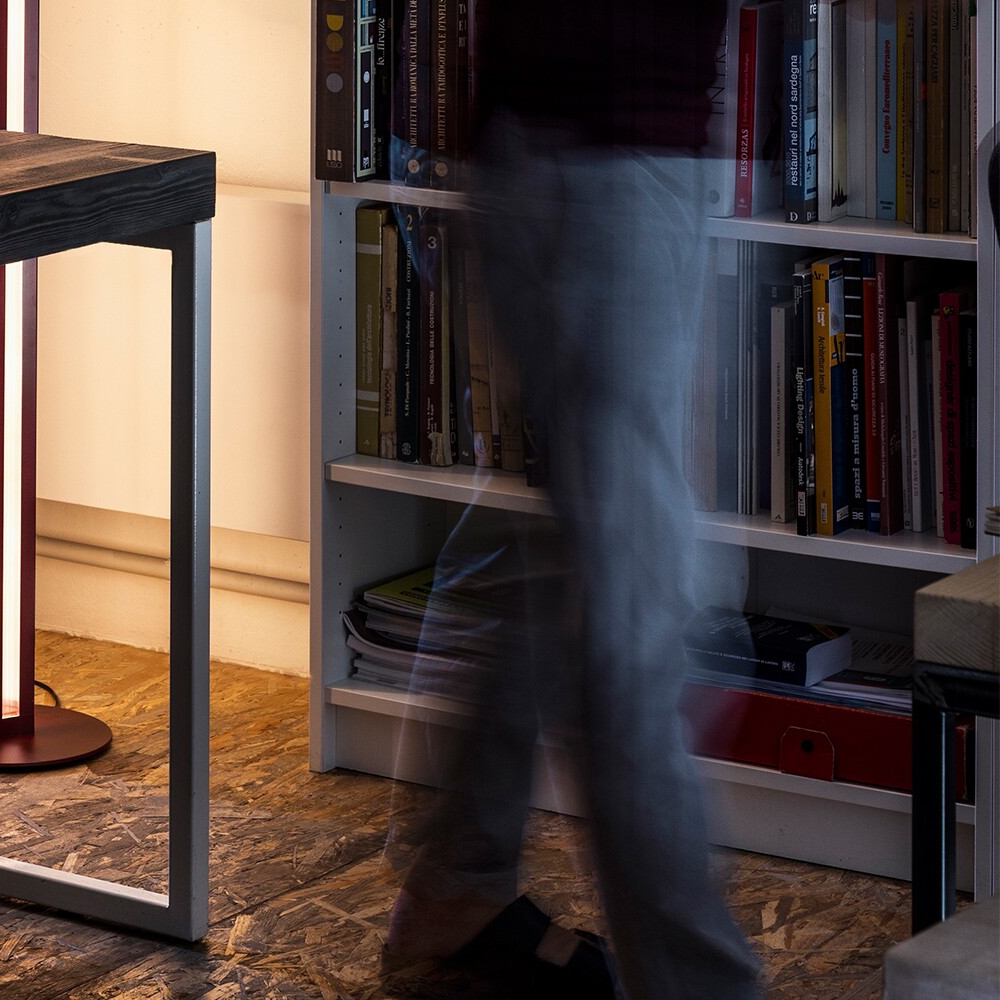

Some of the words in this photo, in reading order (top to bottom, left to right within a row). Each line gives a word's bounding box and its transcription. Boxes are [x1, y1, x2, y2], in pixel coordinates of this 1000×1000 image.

[408, 30, 418, 54] DALLA
[930, 28, 938, 42] PER
[408, 55, 418, 92] ROMANICA
[437, 39, 447, 92] TARDOGOTICA
[789, 55, 799, 102] sardegna
[882, 40, 891, 113] Euromediterraneo
[930, 44, 938, 84] CAGLIARI
[408, 93, 418, 149] ARCHITETTURA
[437, 93, 447, 150] ARCHITETTURA
[789, 104, 798, 128] nord
[882, 115, 892, 154] Convegno
[740, 128, 749, 178] RESORZAS
[789, 130, 798, 146] nel
[789, 148, 798, 186] restauri
[406, 214, 413, 231] 2
[427, 236, 437, 249] 3
[818, 335, 826, 373] Architettura
[795, 367, 805, 402] Lighting
[819, 374, 827, 394] tessile
[850, 368, 859, 411] d'uomo
[946, 360, 957, 406] designer
[796, 404, 805, 435] Design
[947, 408, 957, 418] di
[852, 414, 860, 455] misura
[946, 420, 956, 448] spazi
[853, 457, 860, 465] a
[947, 451, 957, 501] espositivi
[852, 467, 862, 499] spazi
